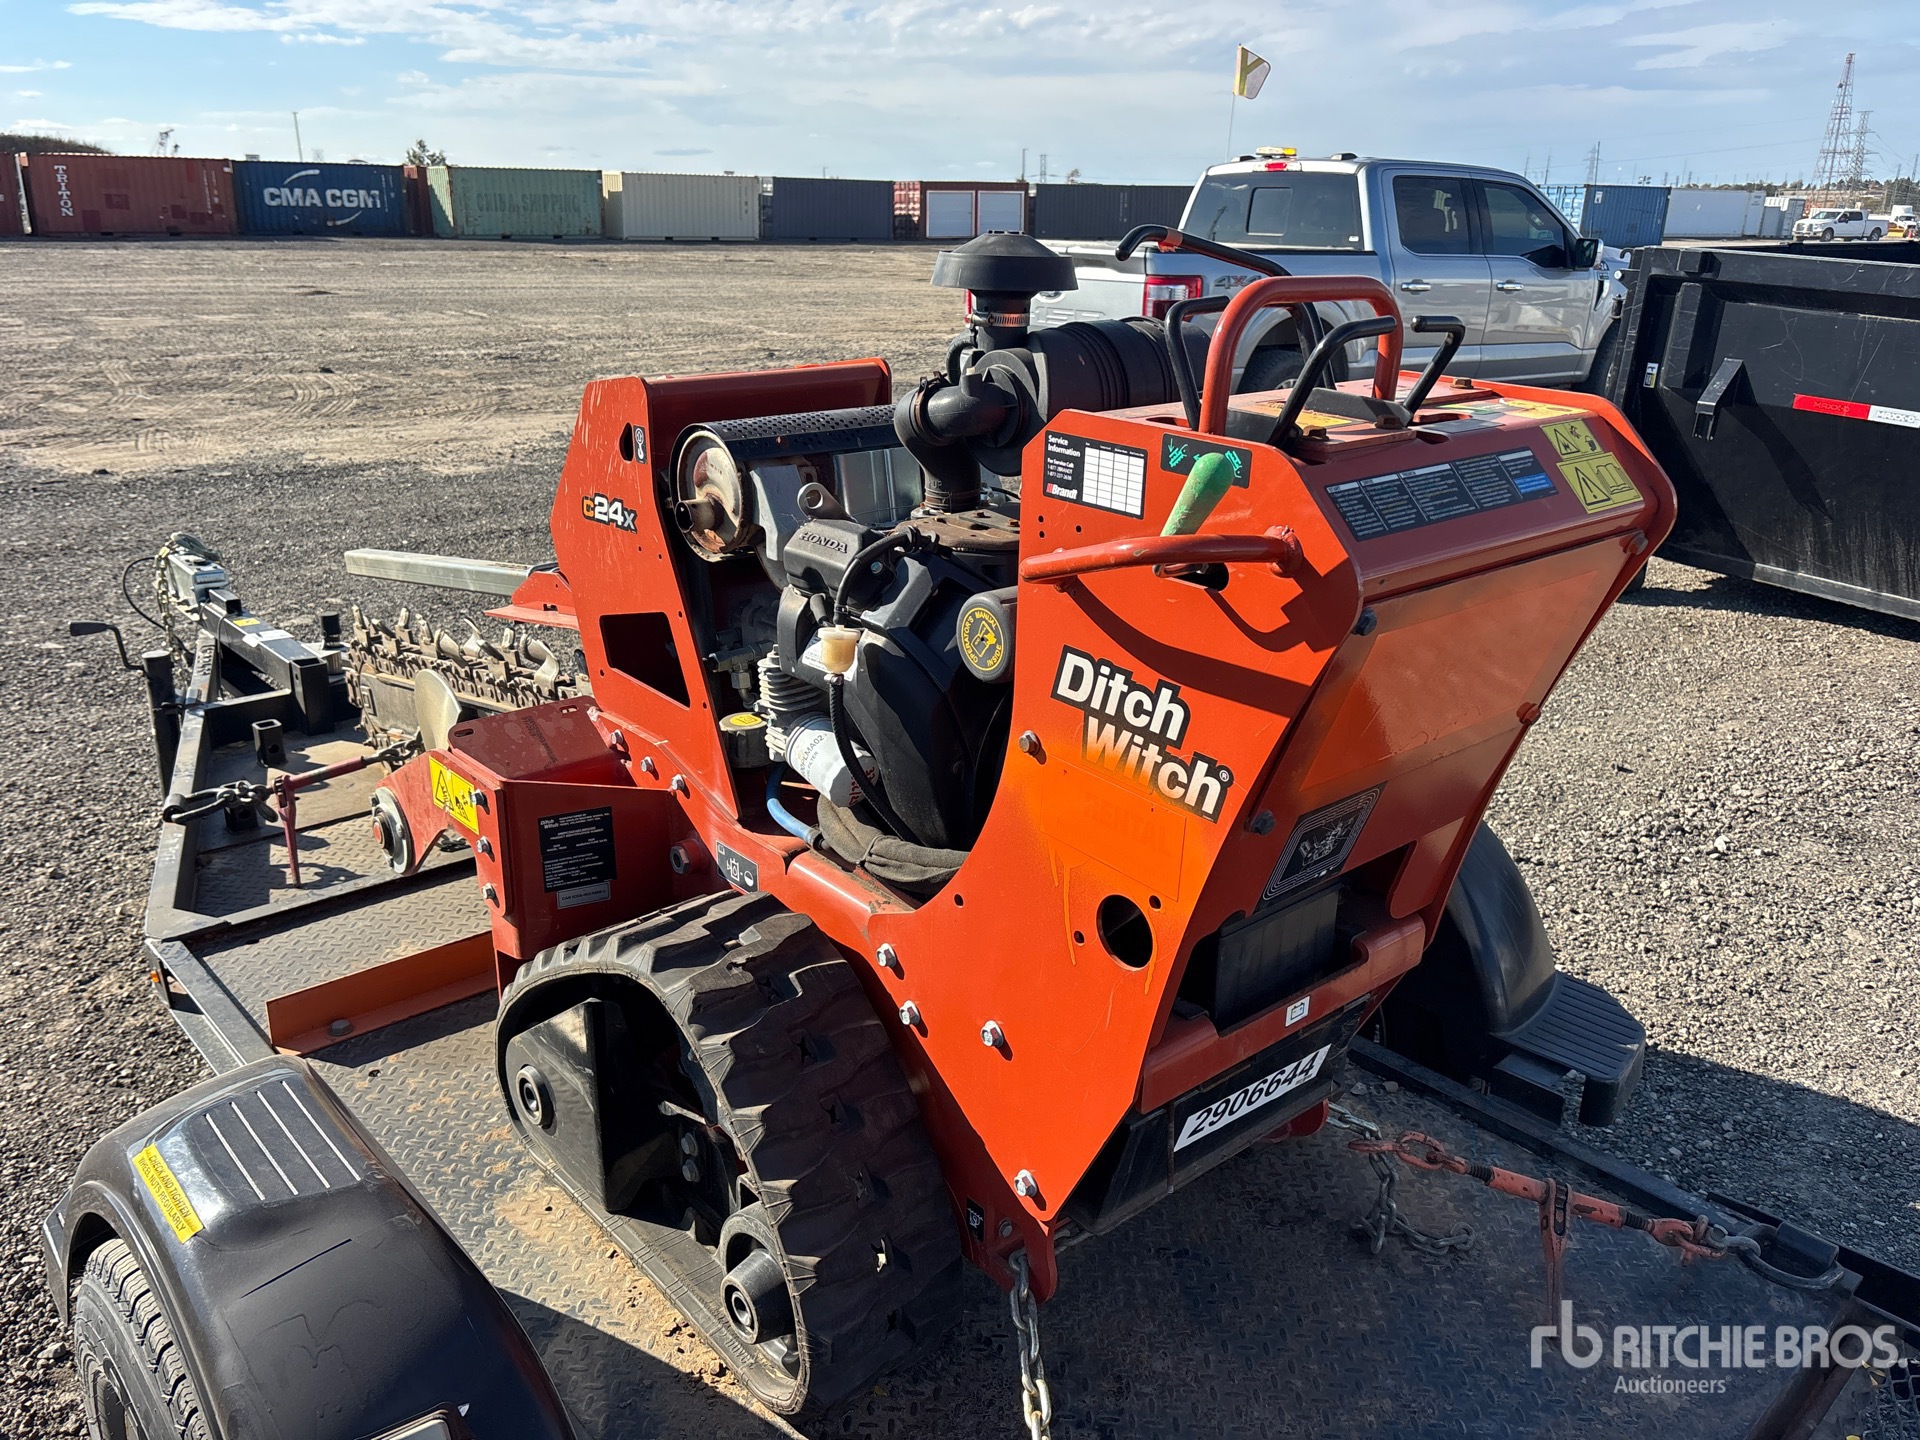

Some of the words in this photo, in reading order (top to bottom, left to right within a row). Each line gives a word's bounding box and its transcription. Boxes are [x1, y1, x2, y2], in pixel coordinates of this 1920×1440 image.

[54, 165, 74, 217] TRITON
[263, 187, 322, 208] CMA
[326, 189, 381, 209] CGM
[521, 193, 581, 213] SHIPPING
[1047, 443, 1081, 458] Information
[1048, 434, 1069, 446] Service
[1052, 484, 1078, 500] Brandt
[799, 531, 848, 554] HONDA
[962, 615, 979, 664] OPERATOR'S
[974, 610, 998, 631] MANUAL
[986, 643, 1002, 667] INSIDE
[1056, 652, 1185, 742] Ditch
[1186, 1050, 1321, 1140] 2906644
[148, 1154, 165, 1176] CHECK
[161, 1172, 174, 1189] AND
[169, 1186, 192, 1218] TIGHTEN
[150, 1174, 162, 1193] NUTS
[159, 1189, 187, 1232] REGULARLY
